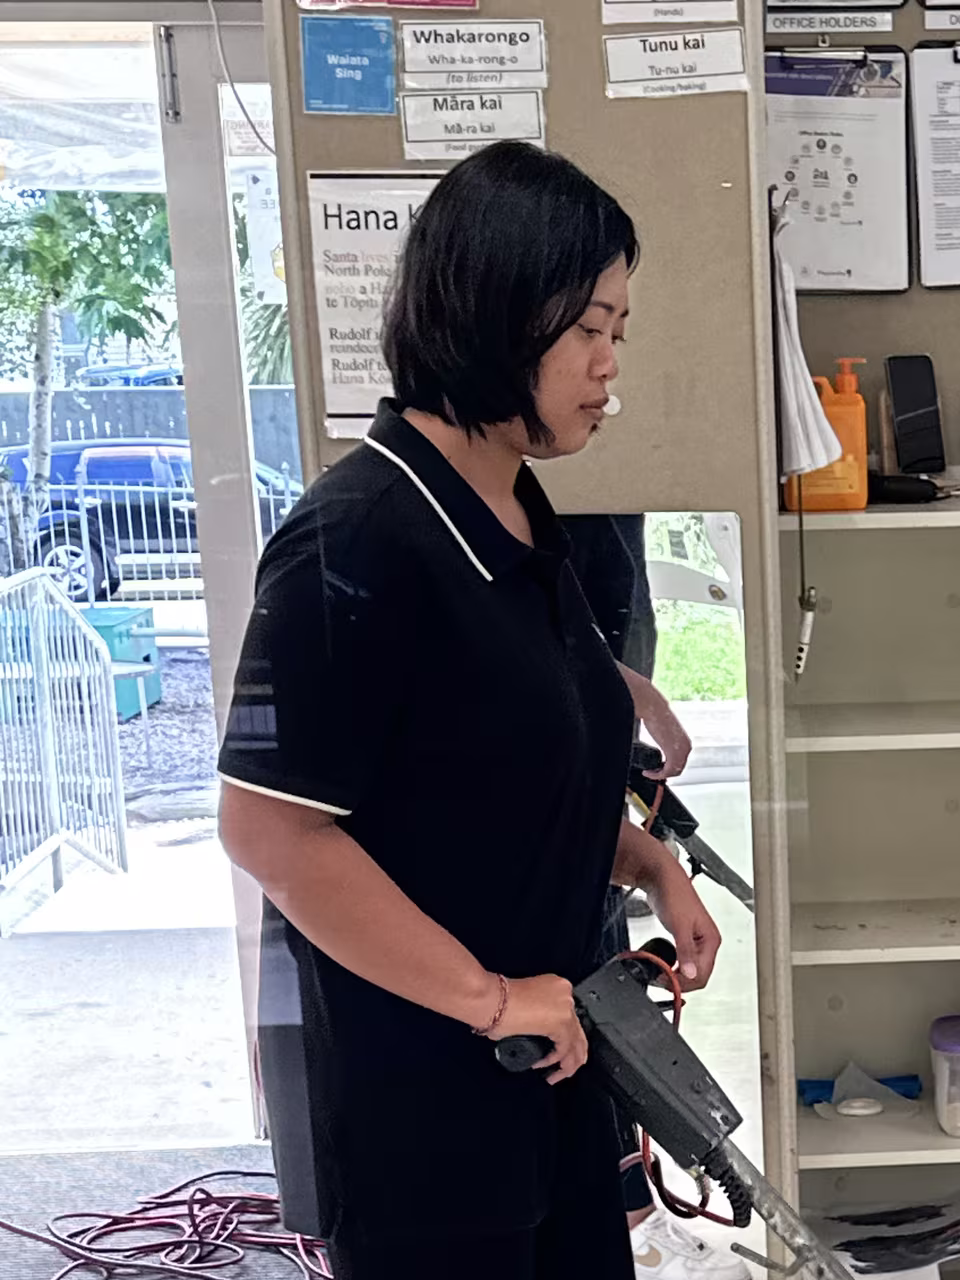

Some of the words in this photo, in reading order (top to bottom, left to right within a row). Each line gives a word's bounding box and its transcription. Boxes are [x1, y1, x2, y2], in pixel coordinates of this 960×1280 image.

[773, 17, 817, 29] OFFICE
[818, 16, 877, 28] HOLDERS
[412, 29, 531, 47] Whakarongo
[639, 38, 679, 53] Tunu
[682, 34, 706, 51] kai
[326, 53, 370, 67] Waiata
[427, 53, 519, 67] Wha-ka-rong-o
[334, 67, 363, 81] Sing
[648, 65, 680, 76] Tu-nu
[681, 63, 698, 74] kai
[445, 72, 464, 84] (to
[465, 71, 504, 84] listen)
[479, 94, 503, 111] kai
[479, 122, 496, 134] kai
[322, 203, 399, 231] Hana
[323, 249, 359, 264] Santa
[324, 264, 361, 278] North
[358, 284, 368, 295] a
[328, 327, 372, 341] Rudolf
[331, 357, 374, 372] Rudolf
[331, 372, 365, 385] Hana
